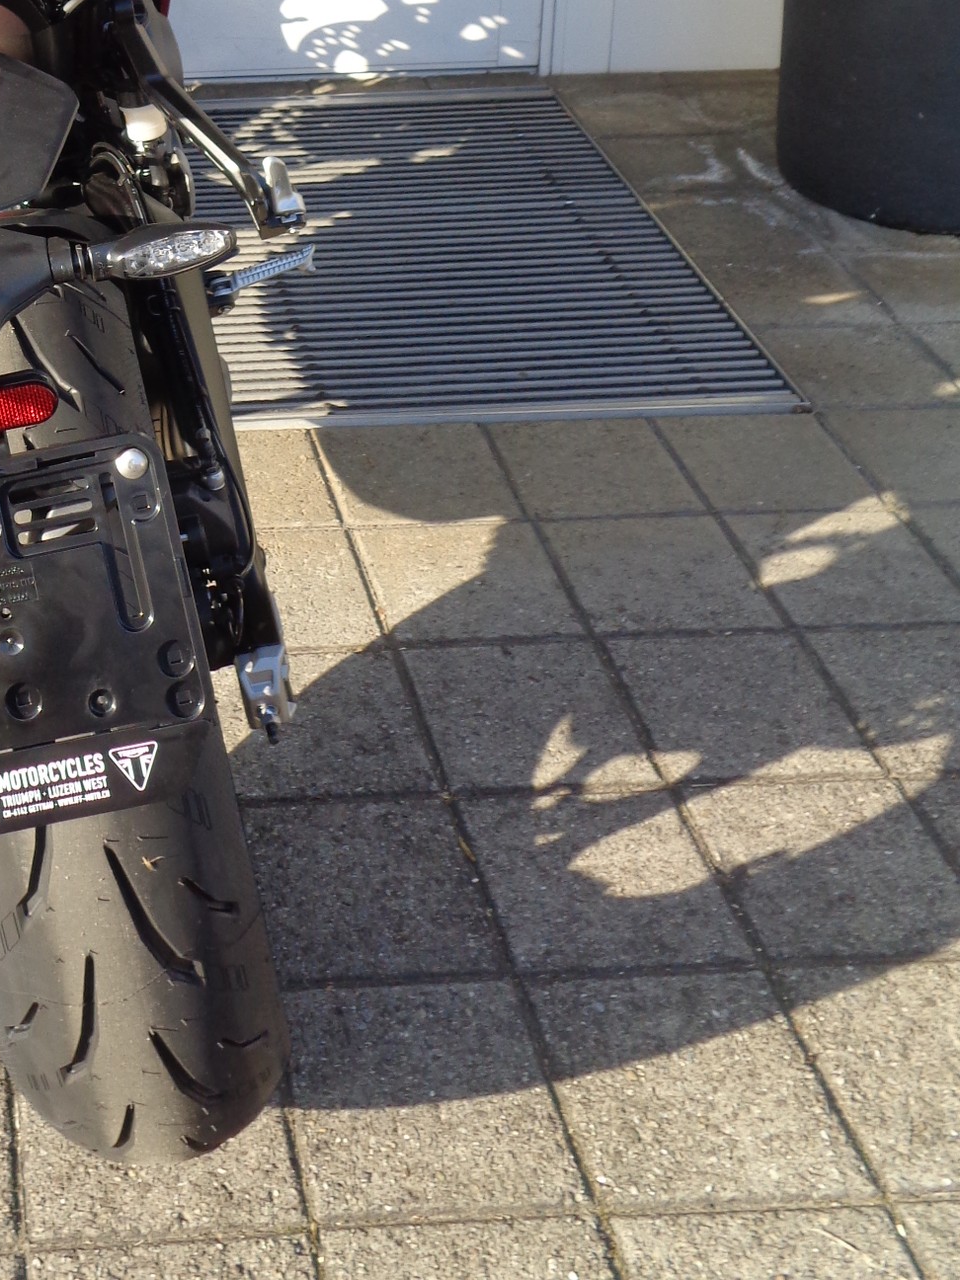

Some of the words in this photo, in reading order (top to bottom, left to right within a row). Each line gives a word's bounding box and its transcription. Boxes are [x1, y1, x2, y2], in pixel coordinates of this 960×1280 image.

[0, 789, 42, 809] TRIUMPH
[48, 780, 82, 799] LUZERN
[83, 776, 108, 791] WEST
